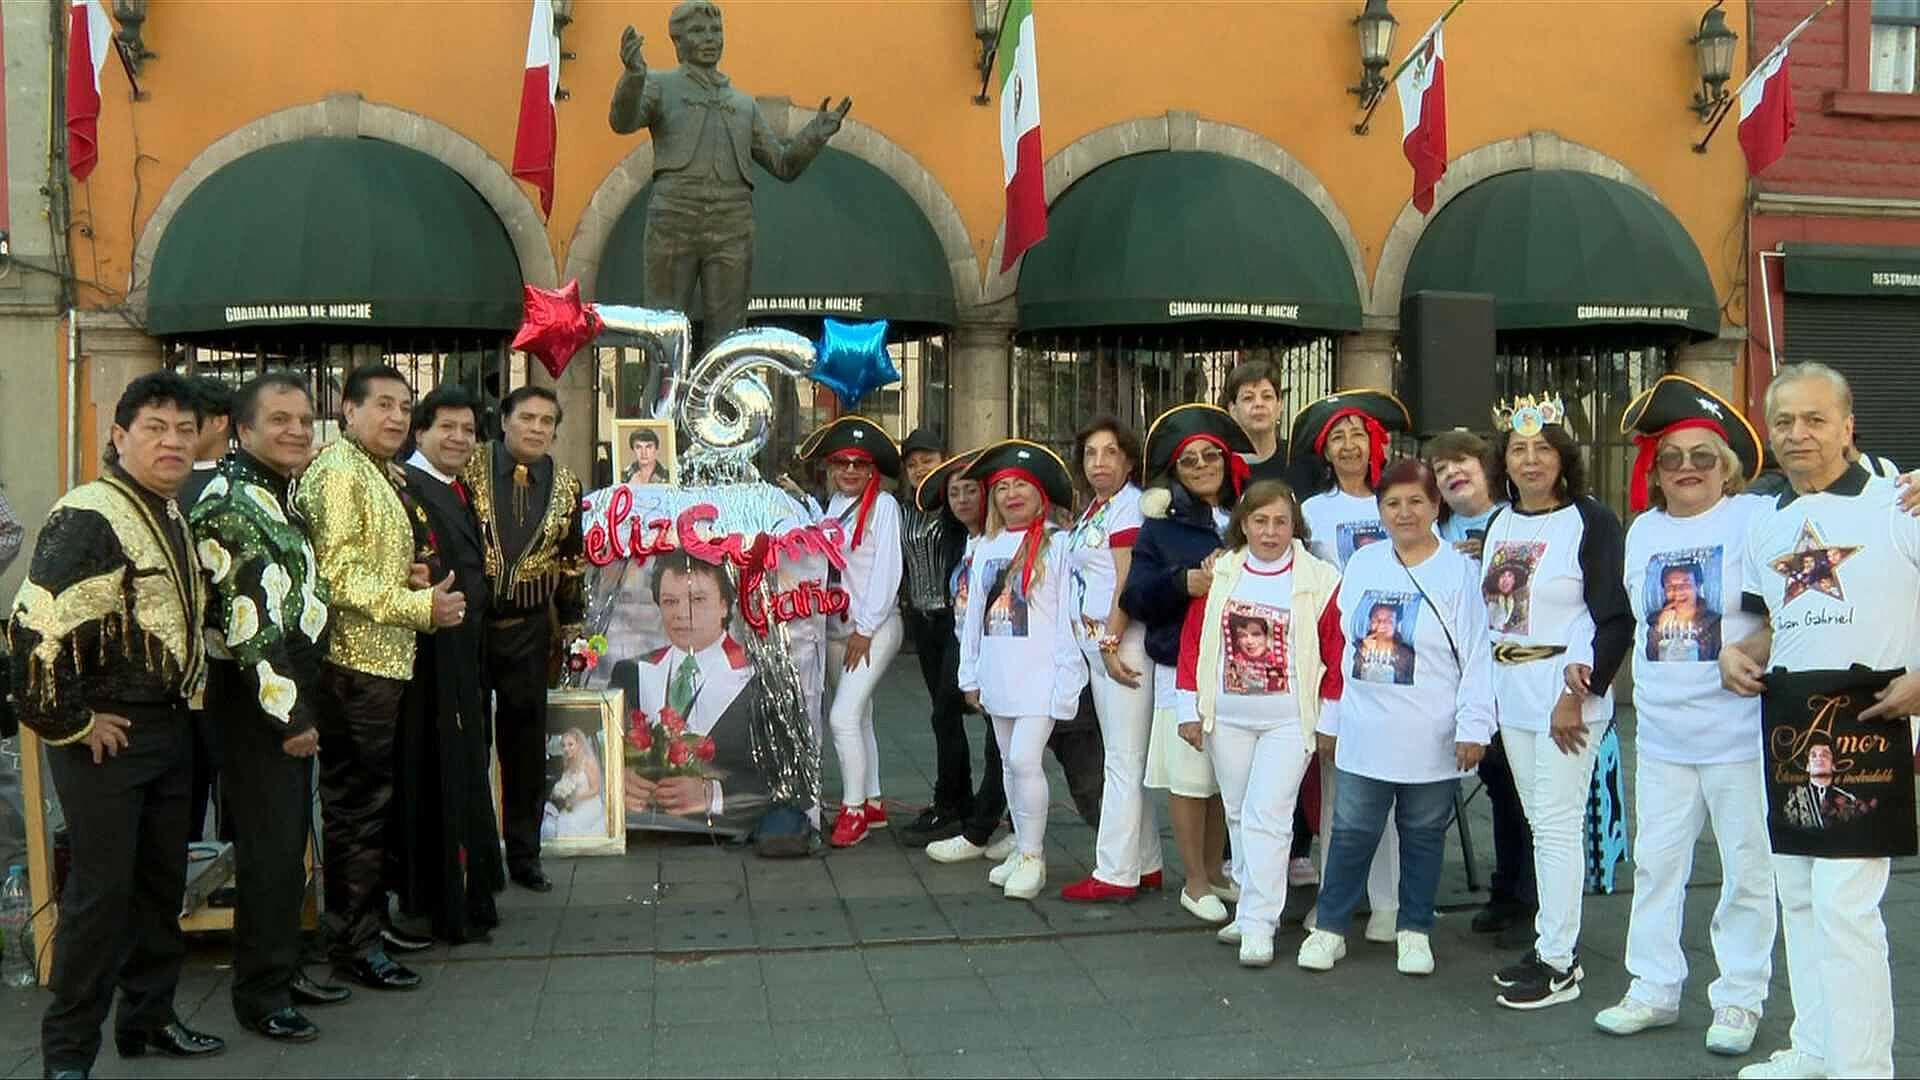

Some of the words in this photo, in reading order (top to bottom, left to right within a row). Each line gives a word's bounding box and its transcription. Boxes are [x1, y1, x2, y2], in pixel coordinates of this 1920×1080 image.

[1872, 272, 1920, 287] RESTAURA
[225, 303, 308, 322] GUADALAJARA
[310, 304, 327, 318] DE
[329, 303, 372, 319] NOCHE
[808, 297, 824, 311] DE
[825, 297, 864, 313] NOCHE
[1169, 302, 1249, 317] GUADALAJARA
[1250, 304, 1265, 316] DE
[1265, 304, 1300, 320] NOCHE
[581, 484, 675, 567] eliz
[1776, 612, 1800, 630] uan
[1804, 607, 1855, 627] Gabriel
[1771, 695, 1890, 772] Amor
